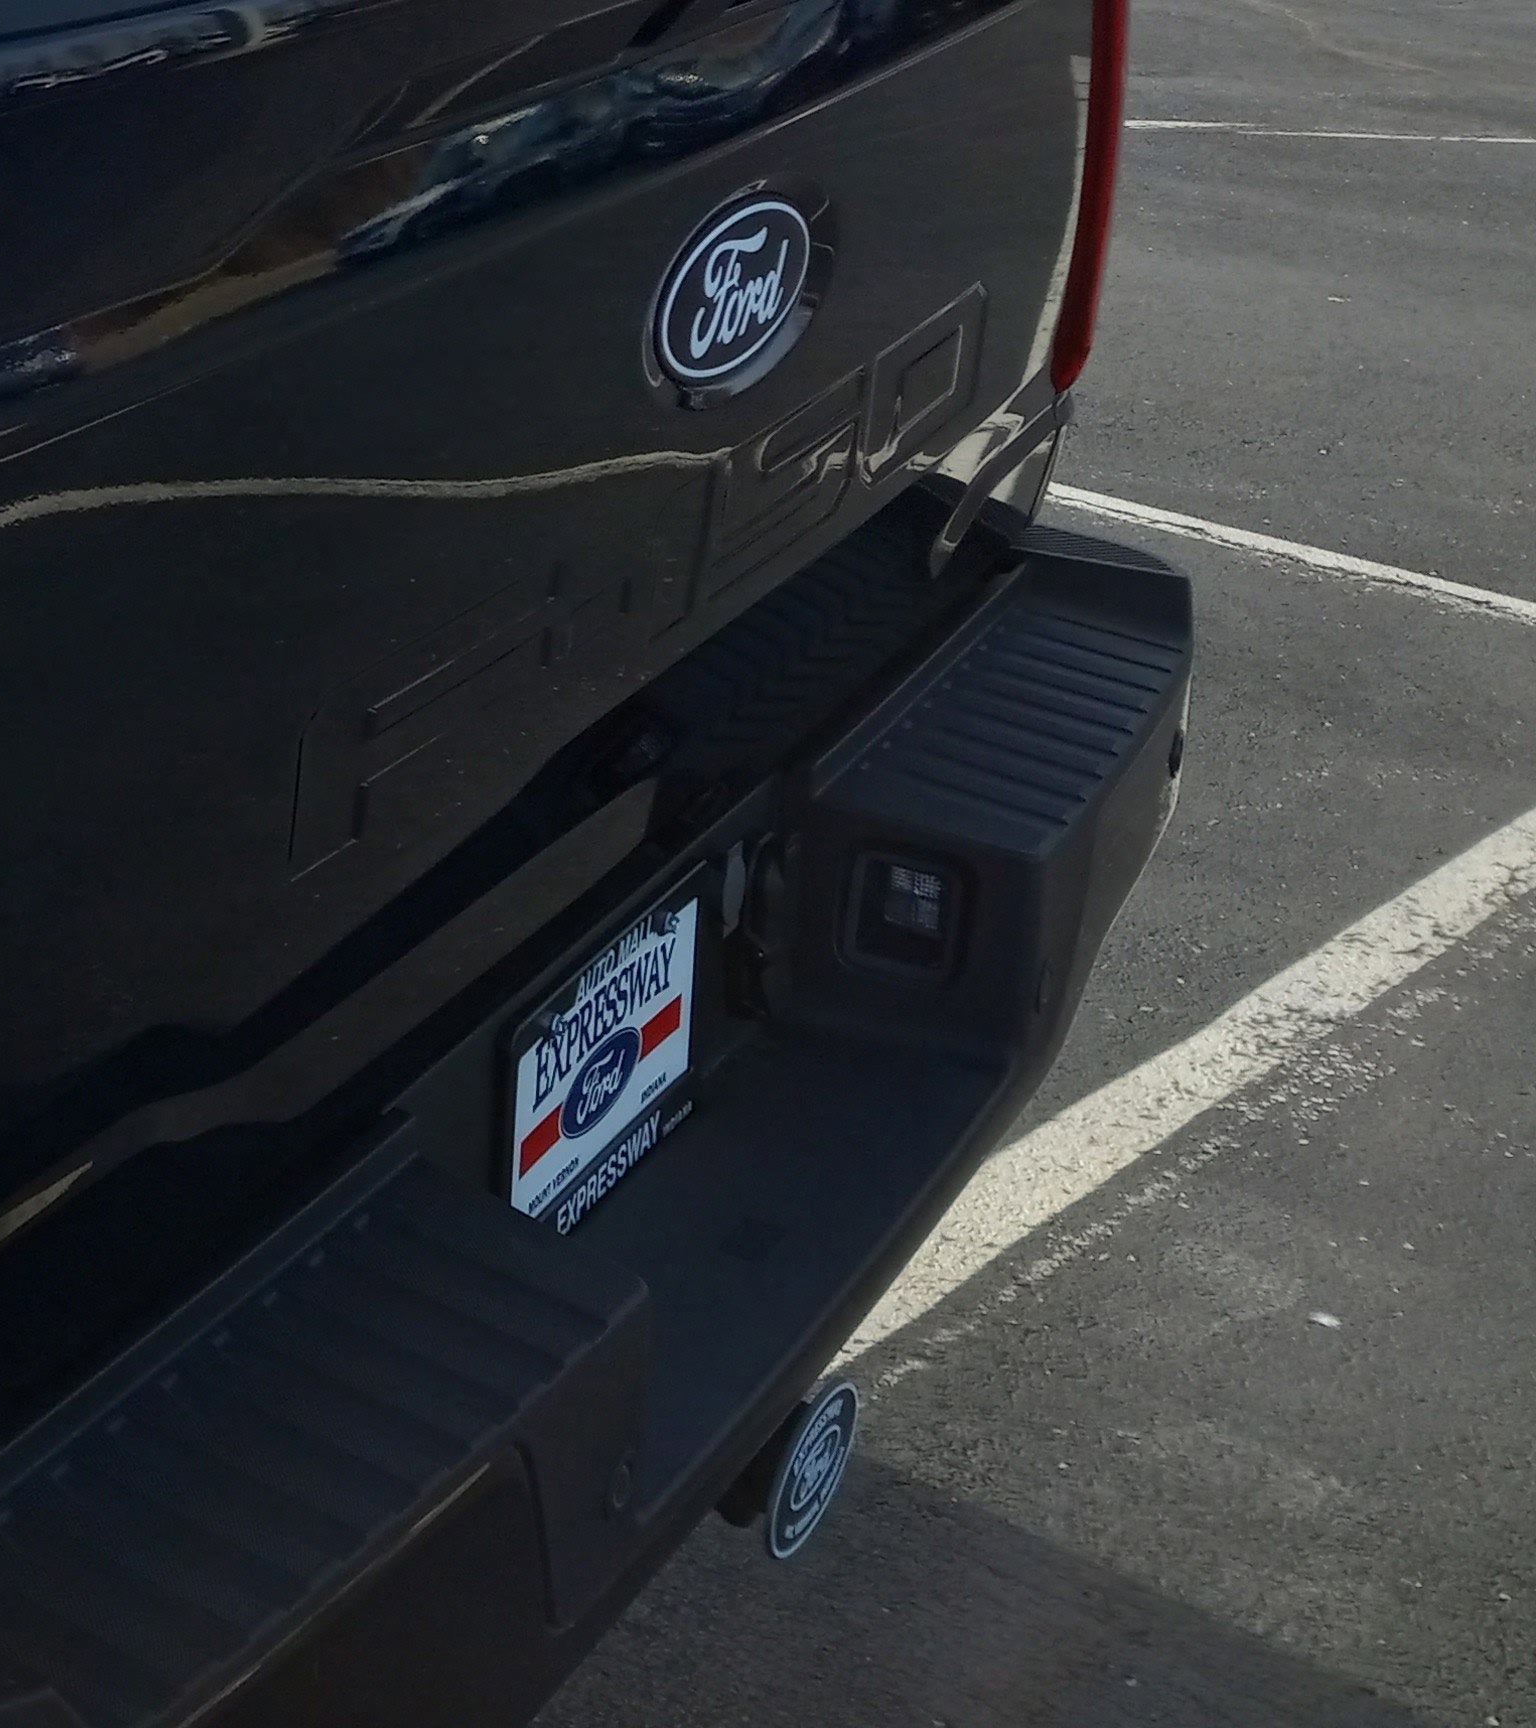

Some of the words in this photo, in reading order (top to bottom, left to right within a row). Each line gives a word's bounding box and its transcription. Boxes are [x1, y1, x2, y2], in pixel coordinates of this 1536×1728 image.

[690, 225, 789, 360] Ford
[533, 937, 676, 1113] EXPRESSWAY
[576, 948, 616, 1006] AUTO
[577, 1048, 626, 1125] Ford
[556, 1109, 661, 1236] EXPRESSWAY
